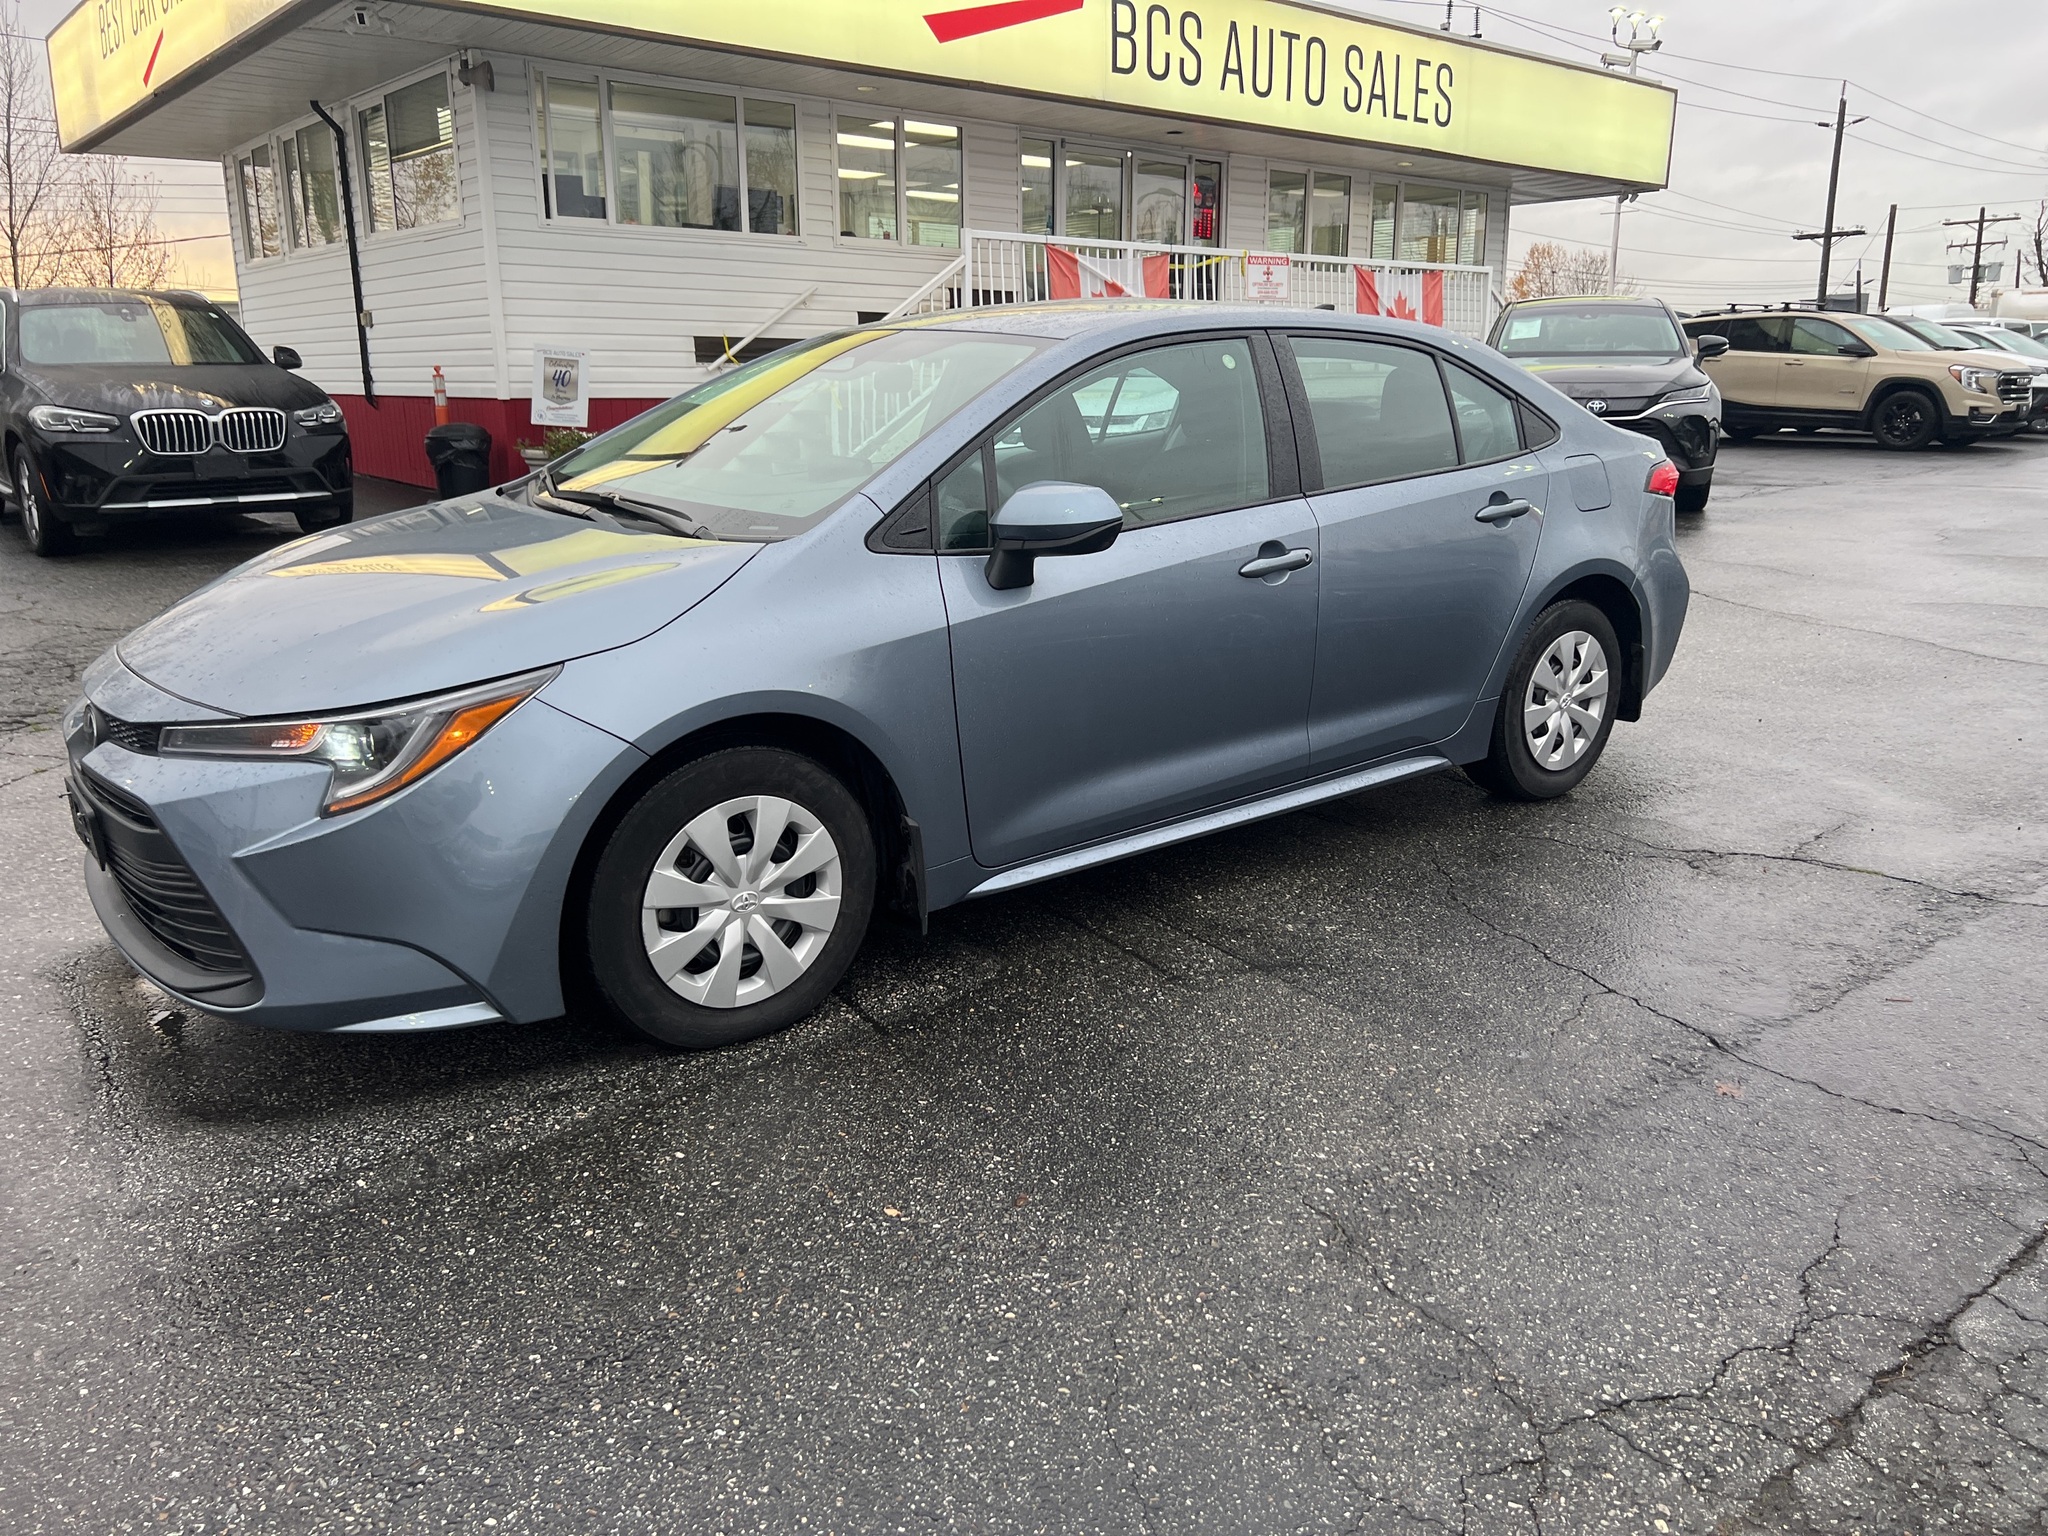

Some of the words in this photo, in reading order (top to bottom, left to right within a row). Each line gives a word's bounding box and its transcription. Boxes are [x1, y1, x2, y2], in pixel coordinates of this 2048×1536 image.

[98, 0, 126, 60] BEST
[1111, 0, 1202, 87] BCS
[1220, 20, 1327, 107] AUTO
[1343, 44, 1454, 128] SALES
[1249, 257, 1287, 266] WARNING
[552, 369, 572, 388] 40
